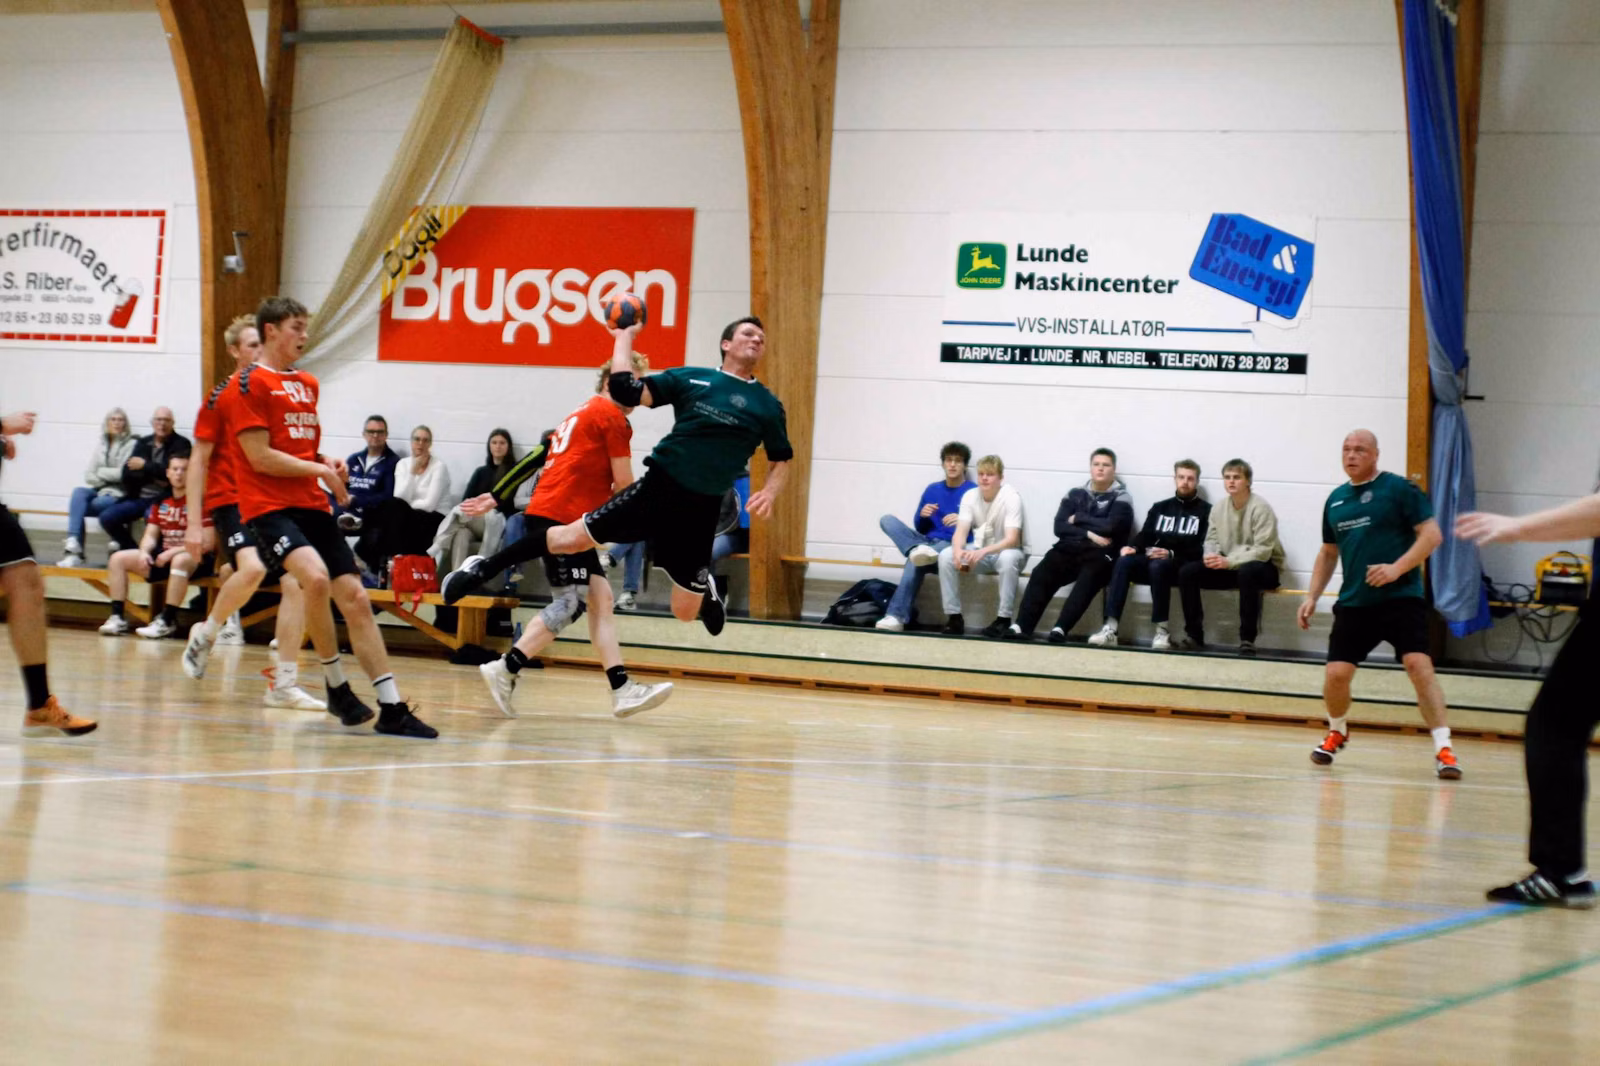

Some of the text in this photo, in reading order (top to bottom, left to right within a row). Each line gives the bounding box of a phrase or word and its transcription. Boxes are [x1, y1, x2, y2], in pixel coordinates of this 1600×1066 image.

[1016, 243, 1089, 263] Lunde
[1210, 214, 1298, 274] Bad &
[26, 271, 73, 291] Riber
[960, 276, 1002, 285] JOHN DEERE
[1015, 272, 1179, 294] Maskincenter
[1200, 241, 1300, 307] Energi
[391, 250, 677, 344] Brugsen
[1017, 317, 1165, 337] VVS-INSTALLATØR
[957, 346, 1289, 371] TARPVEJ 1 LUNDE NR. NEBEL TELEFON 75 28 20 23
[281, 380, 311, 403] 92
[1156, 514, 1200, 536] ITALIA
[228, 532, 244, 547] 45
[273, 535, 291, 556] 92
[571, 567, 587, 579] 89
